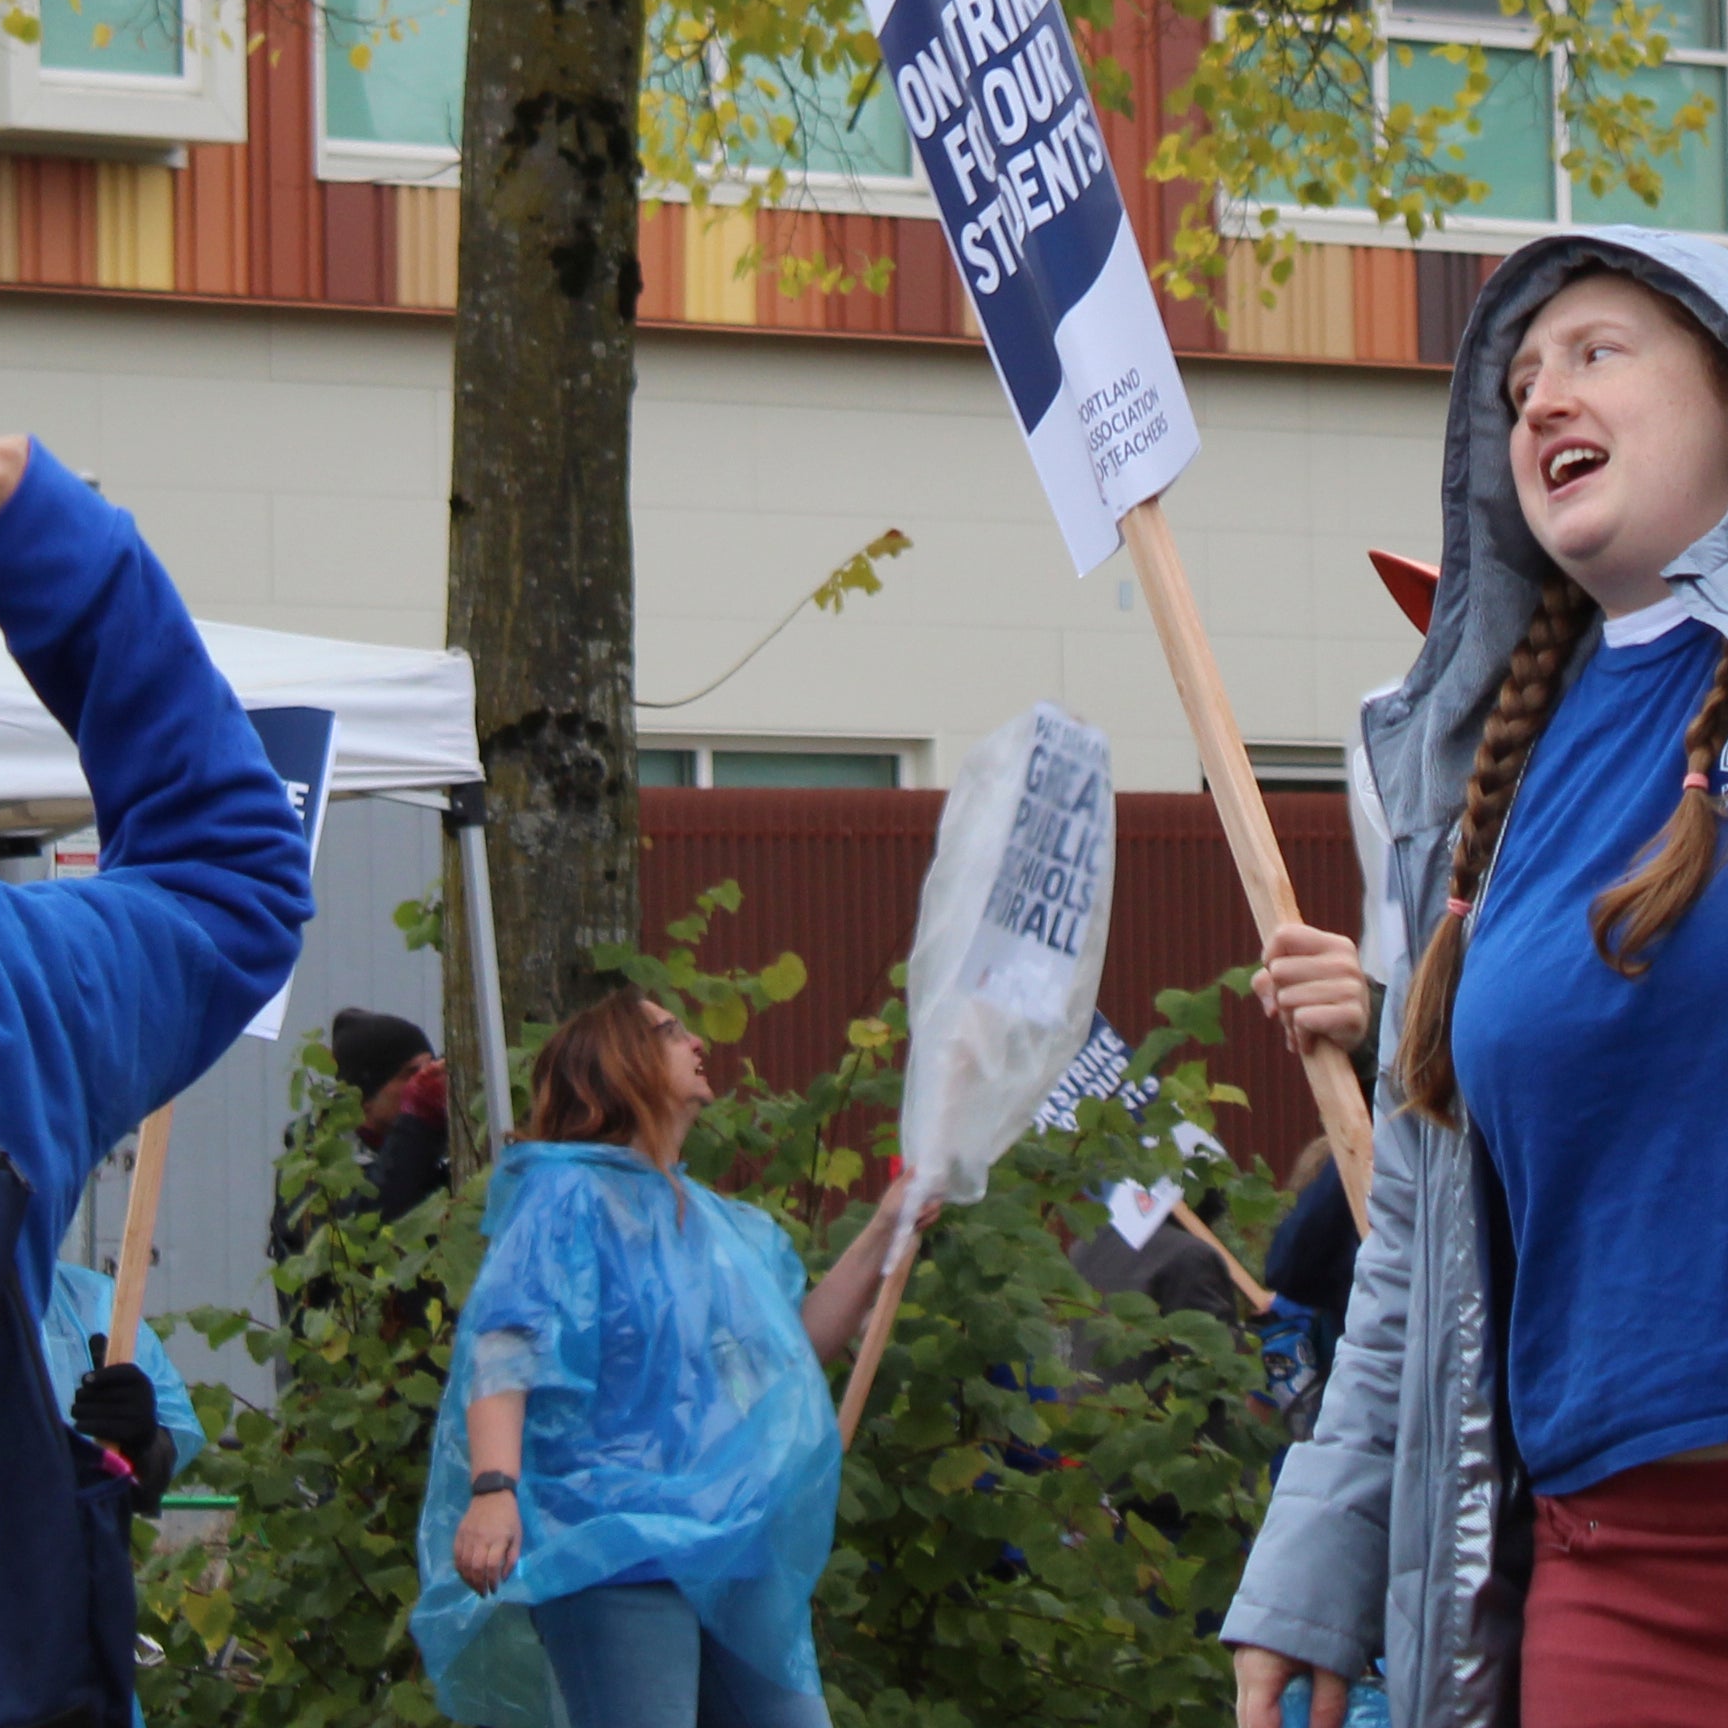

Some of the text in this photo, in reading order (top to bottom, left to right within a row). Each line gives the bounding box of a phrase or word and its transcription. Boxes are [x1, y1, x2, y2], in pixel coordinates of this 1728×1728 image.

[897, 36, 963, 139] ON
[983, 24, 1072, 147] OUR
[1079, 368, 1140, 424] ORTLAND
[1089, 384, 1160, 451] SSOCIATION
[1107, 410, 1169, 472] TEACHERS
[1020, 902, 1081, 958] ALL
